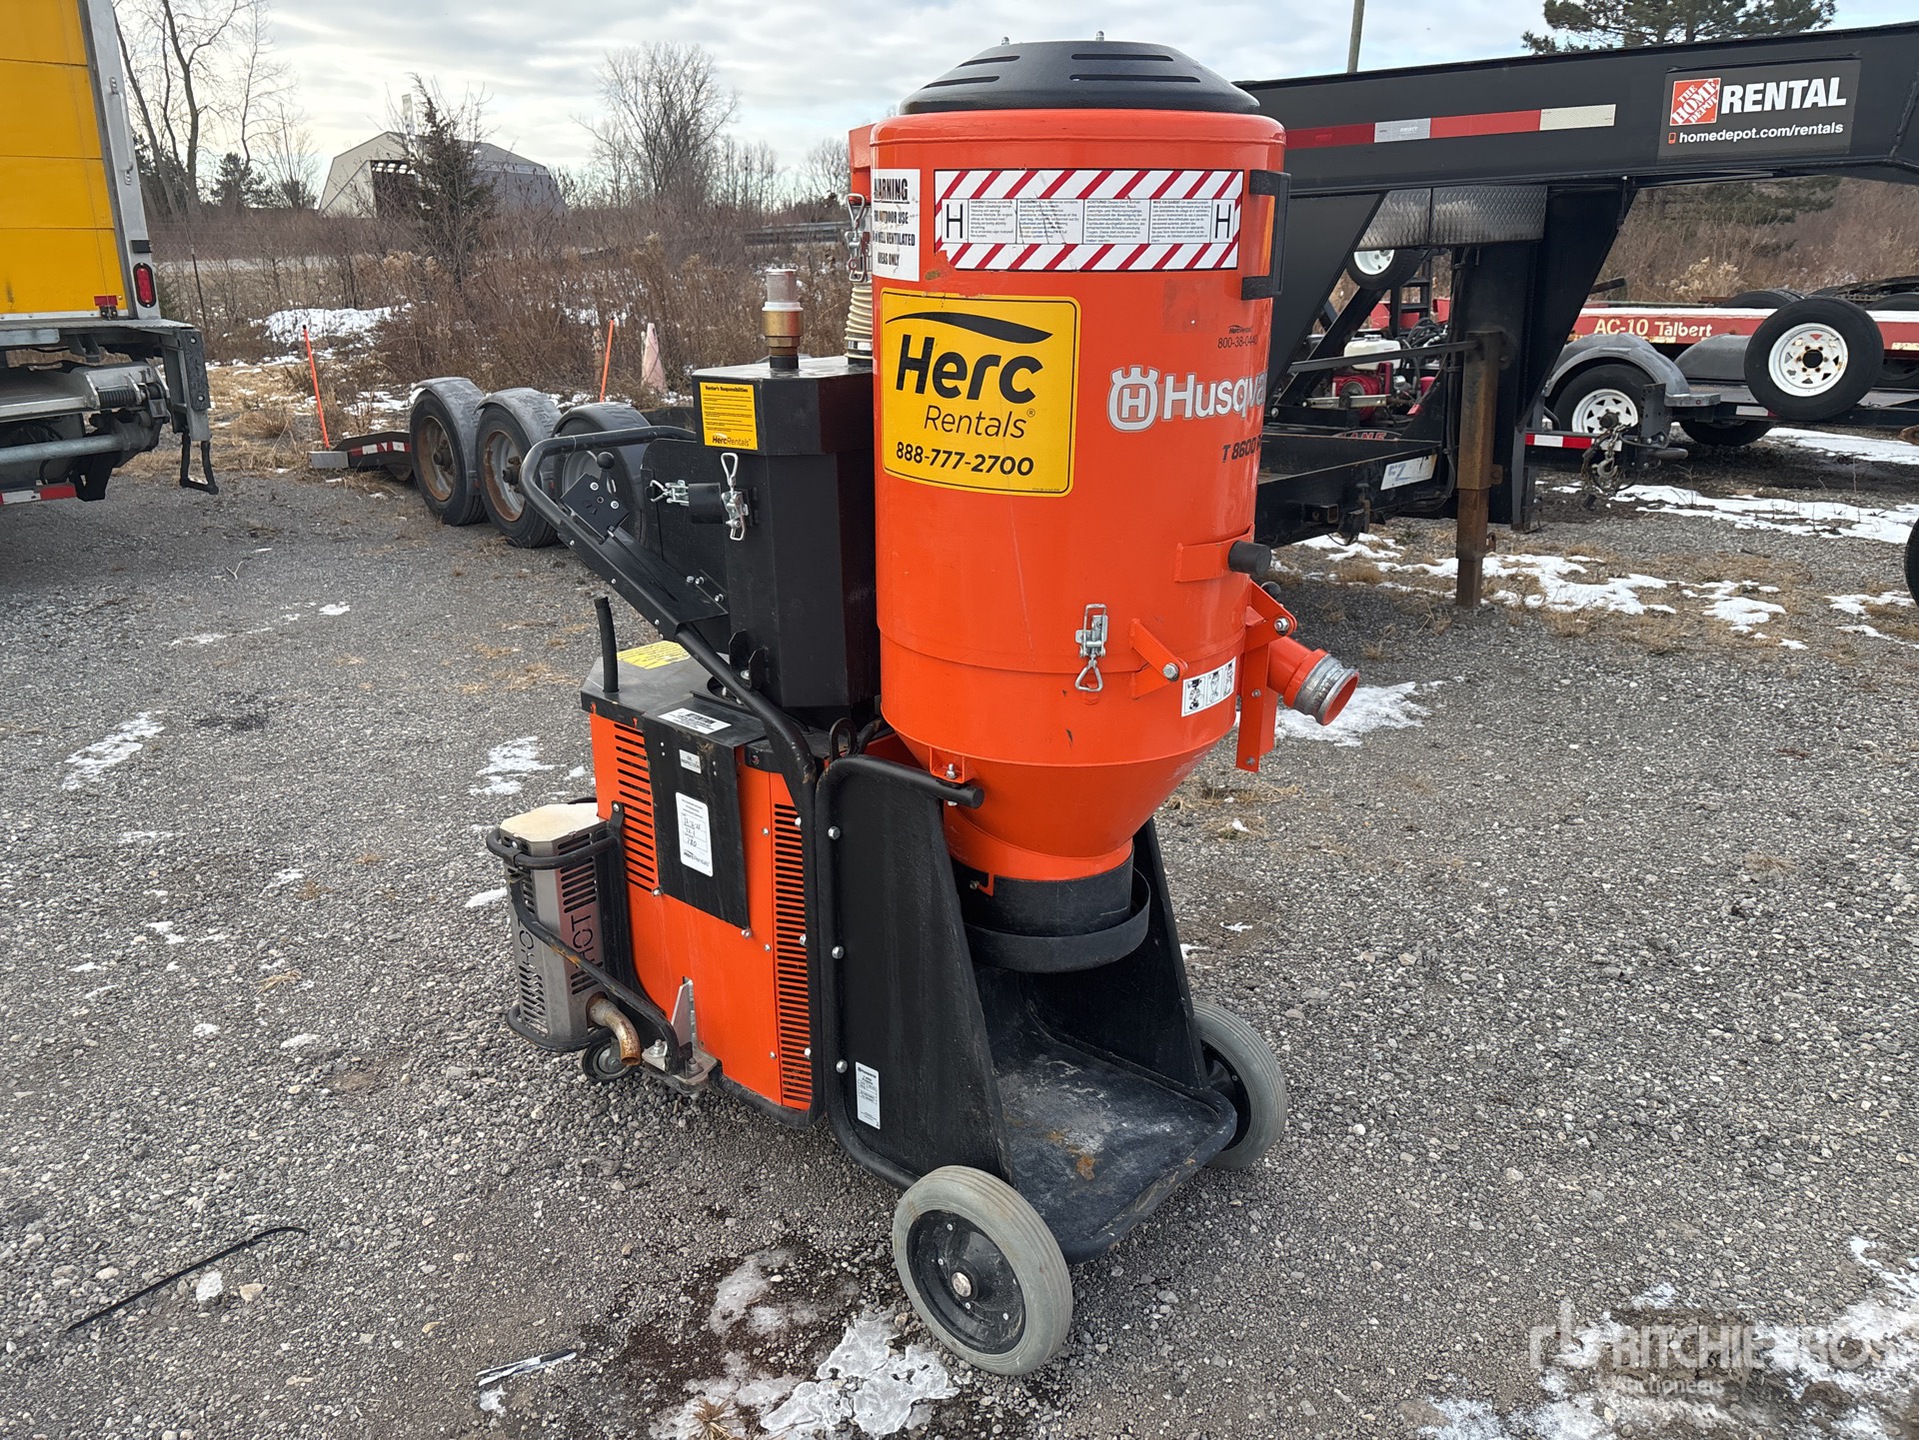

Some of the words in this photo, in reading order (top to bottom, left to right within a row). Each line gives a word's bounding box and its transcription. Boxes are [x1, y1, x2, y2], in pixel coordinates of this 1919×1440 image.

[1670, 79, 1720, 124] HOME
[1677, 85, 1698, 103] THE
[1688, 95, 1718, 123] DEPOT
[1720, 77, 1847, 115] RENTAL
[1679, 122, 1844, 144] homedepot.com/rentals
[898, 211, 908, 224] USE
[946, 203, 963, 239] H
[1215, 203, 1231, 239] H
[887, 232, 915, 246] VENTILATED
[1594, 319, 1648, 335] AC-10
[1654, 321, 1712, 337] Talbert
[896, 334, 1043, 404] Herc
[924, 404, 1028, 439] Rentals
[896, 441, 1035, 477] 888-777-2700
[1223, 444, 1231, 463] T
